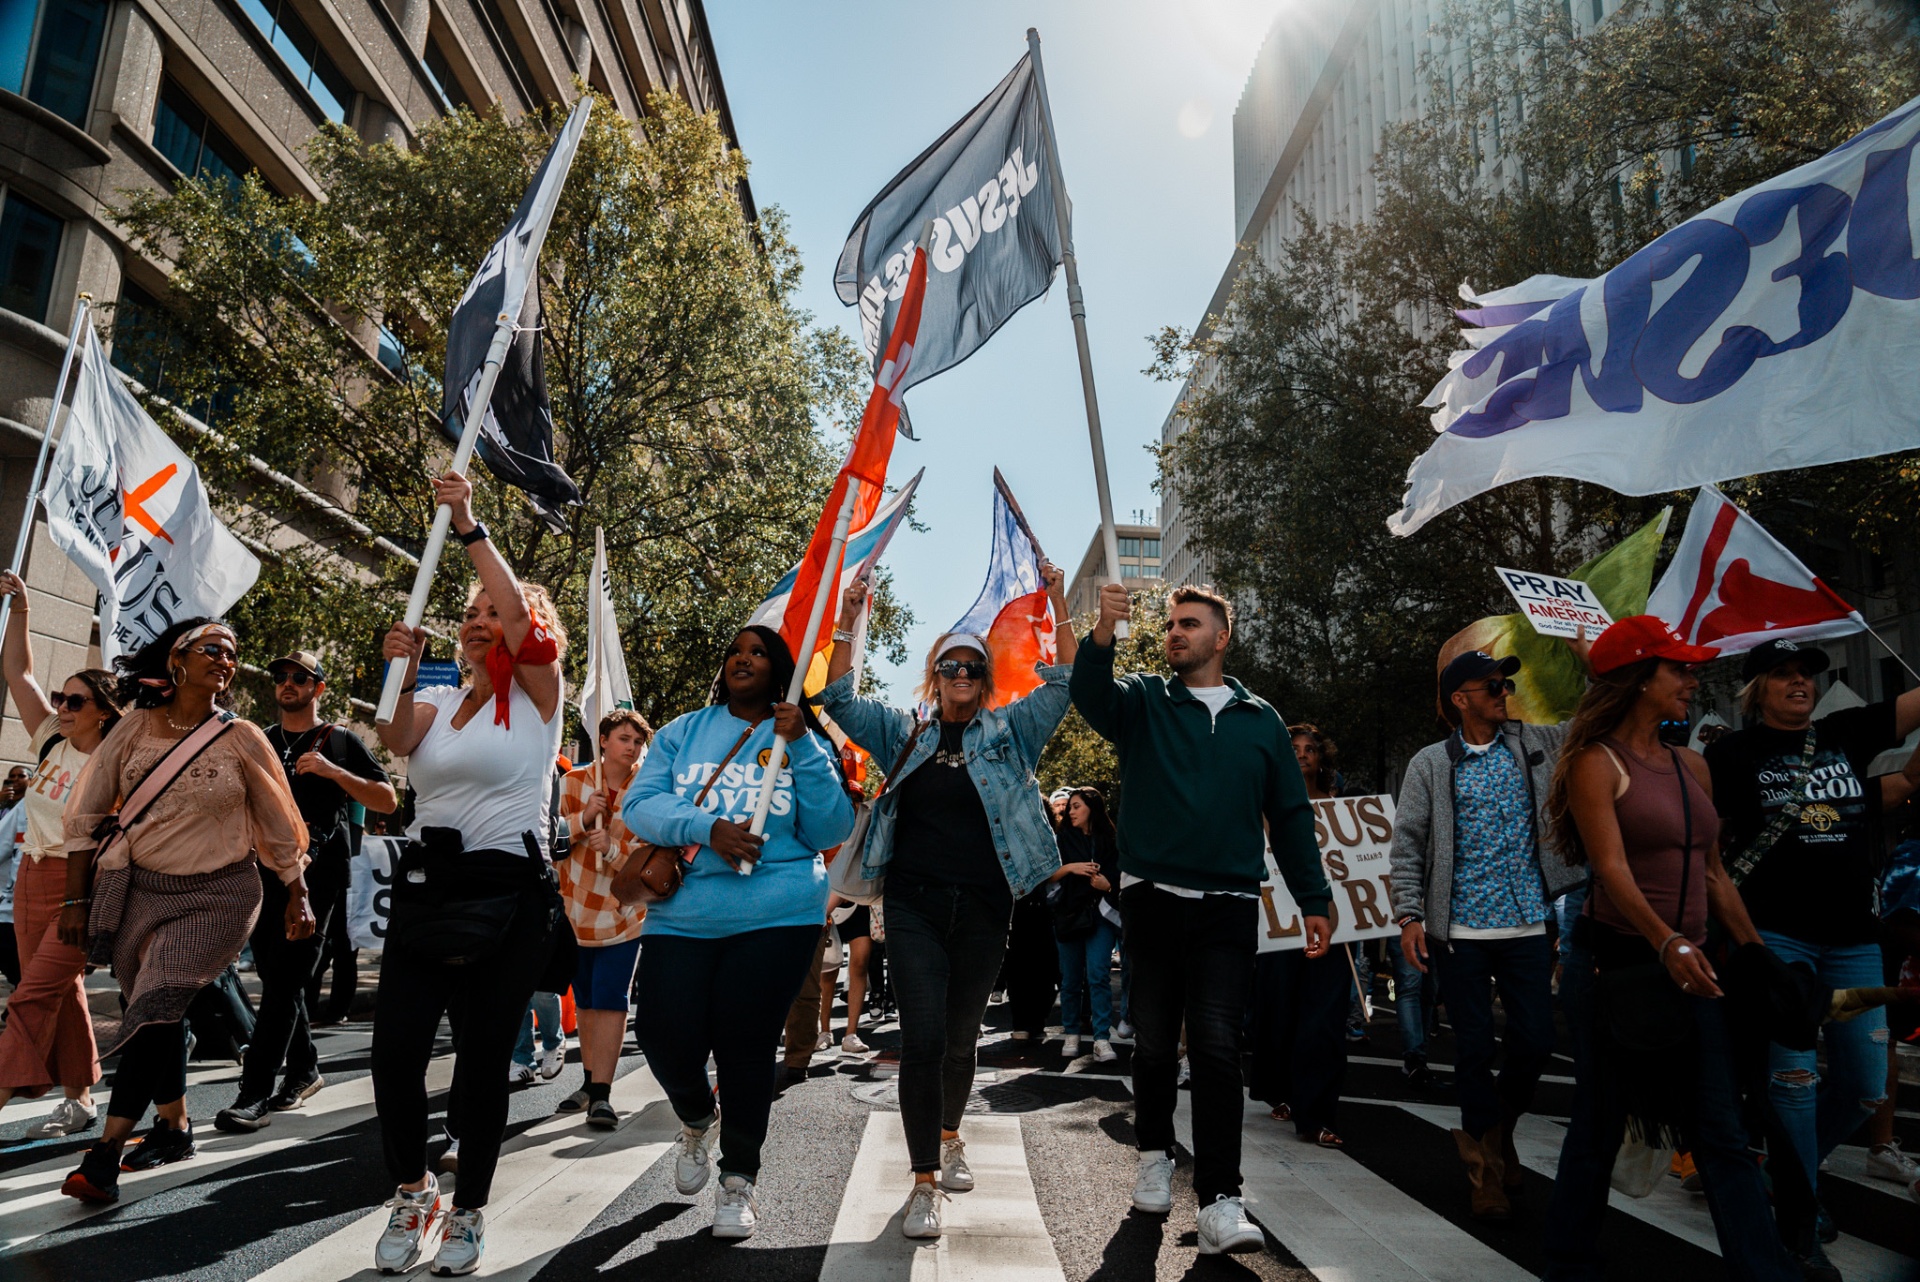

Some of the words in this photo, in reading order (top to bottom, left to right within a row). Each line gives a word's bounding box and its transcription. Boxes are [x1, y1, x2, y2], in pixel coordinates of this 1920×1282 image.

[1503, 572, 1587, 603] PRAY
[1528, 603, 1612, 627] AMERICA
[1545, 597, 1576, 609] FOR
[28, 760, 75, 804] JES
[676, 762, 793, 788] JESUS
[1758, 770, 1790, 784] One
[1795, 762, 1851, 783] ATIO
[1805, 777, 1863, 800] GOD
[1313, 796, 1393, 849] SUS
[1321, 849, 1350, 881] S
[1261, 874, 1398, 940] LR
